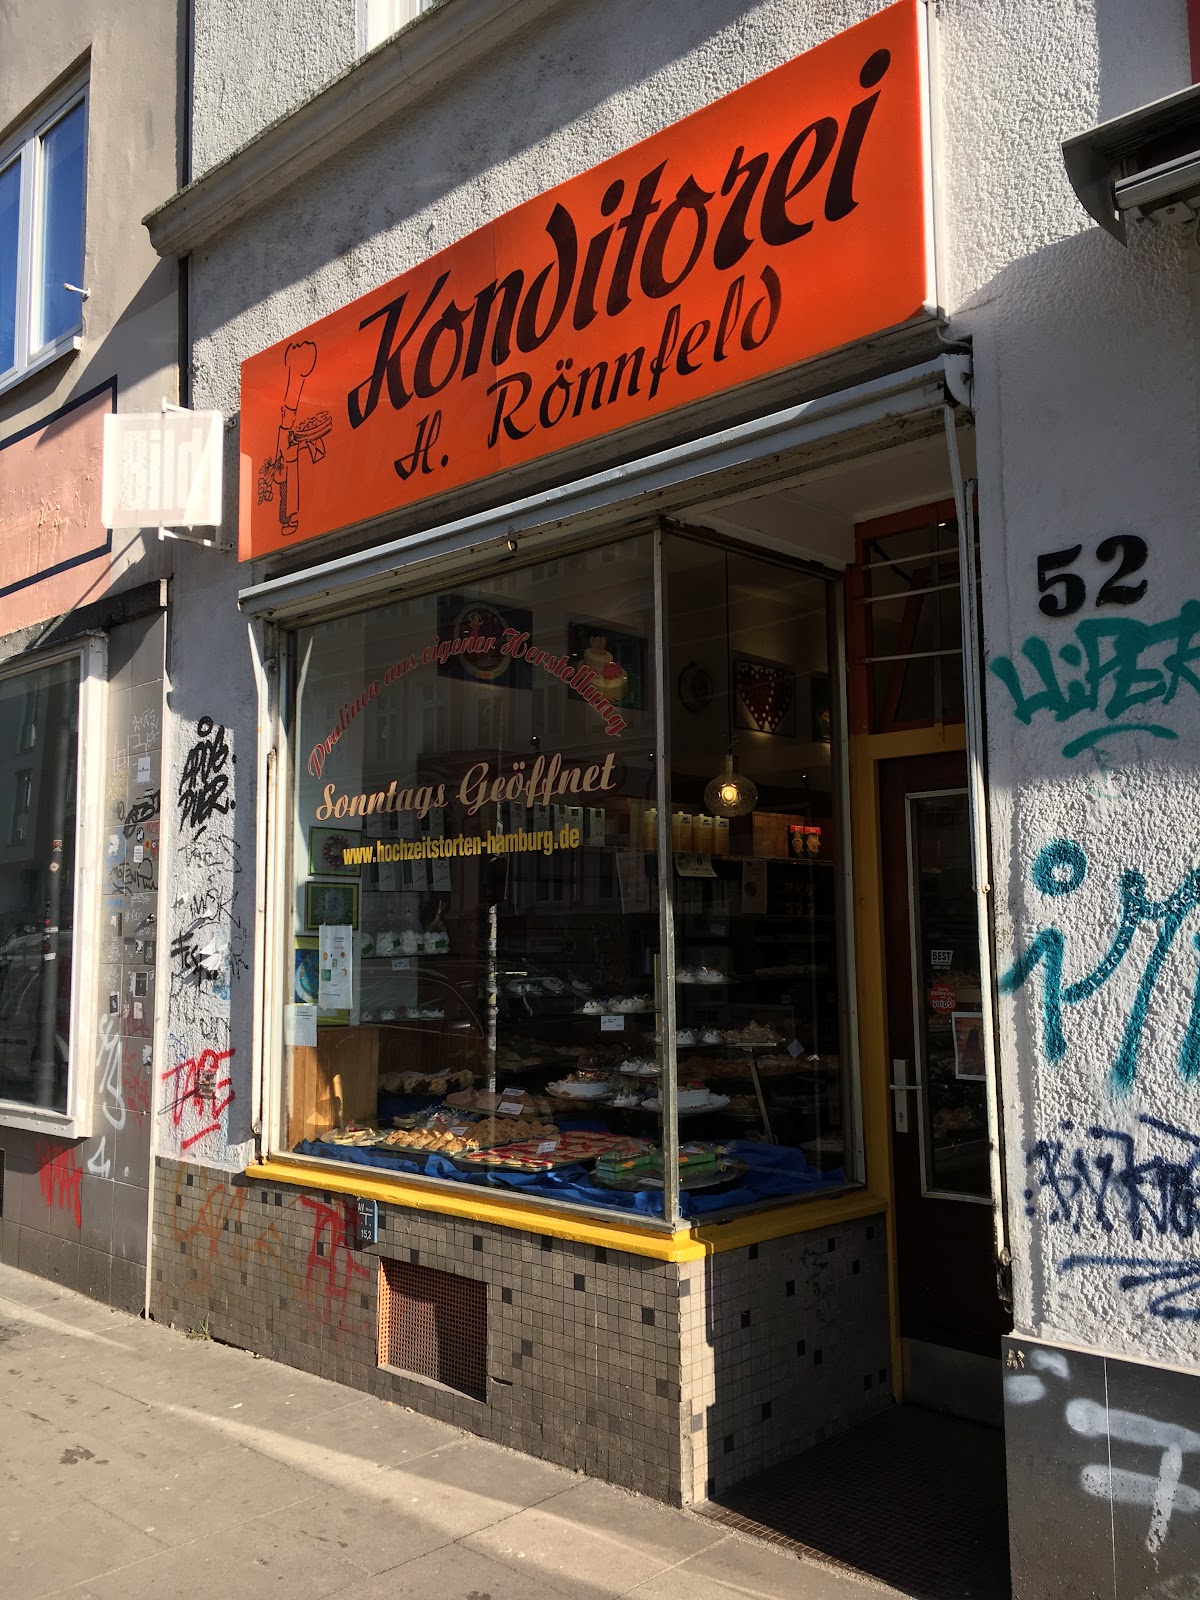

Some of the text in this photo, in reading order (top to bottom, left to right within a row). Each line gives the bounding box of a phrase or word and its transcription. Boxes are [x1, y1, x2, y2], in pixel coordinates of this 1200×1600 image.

[347, 48, 891, 430] Konditorei
[394, 265, 782, 481] H. Rönnfeld
[1037, 534, 1149, 618] 52
[307, 679, 382, 780] Pralinen
[384, 653, 418, 686] aus
[421, 634, 497, 664] eigener
[501, 627, 628, 738] Herstellung
[315, 752, 617, 821] Sonntags Geöffnet
[343, 823, 580, 866] www.hochzeitstorten-hamburg.de
[932, 951, 951, 961] BEST
